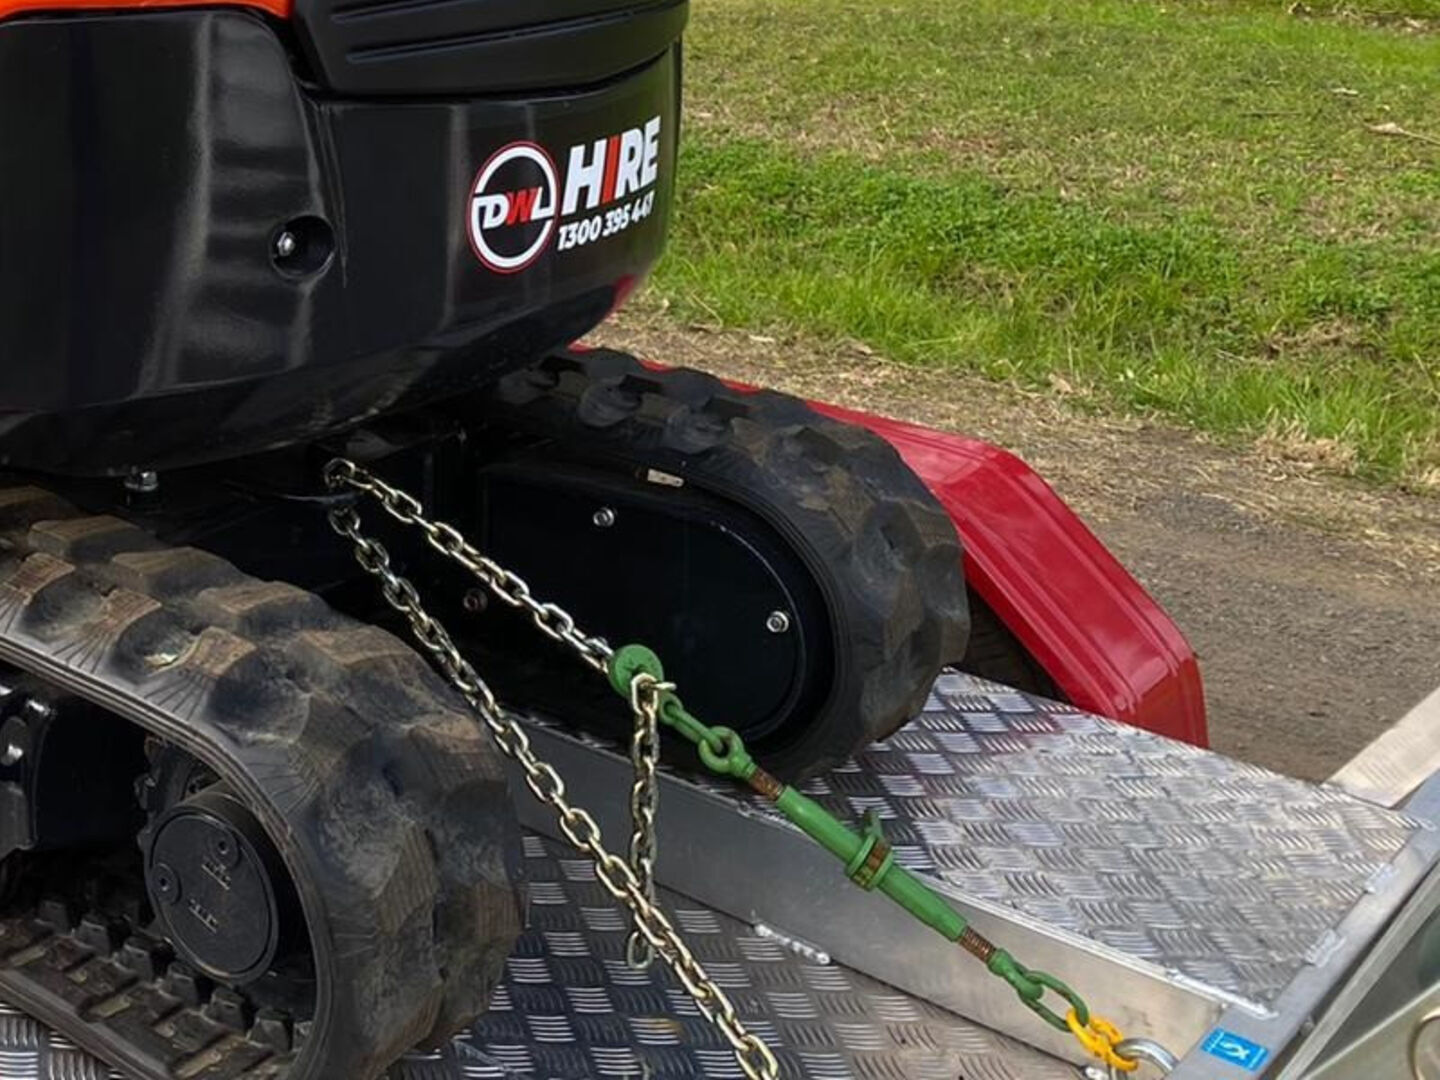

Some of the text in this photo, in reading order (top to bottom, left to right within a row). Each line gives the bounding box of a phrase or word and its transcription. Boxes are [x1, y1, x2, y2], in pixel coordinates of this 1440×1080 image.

[561, 115, 661, 216] HIRE
[557, 215, 602, 252] 1300
[601, 203, 632, 237] 395
